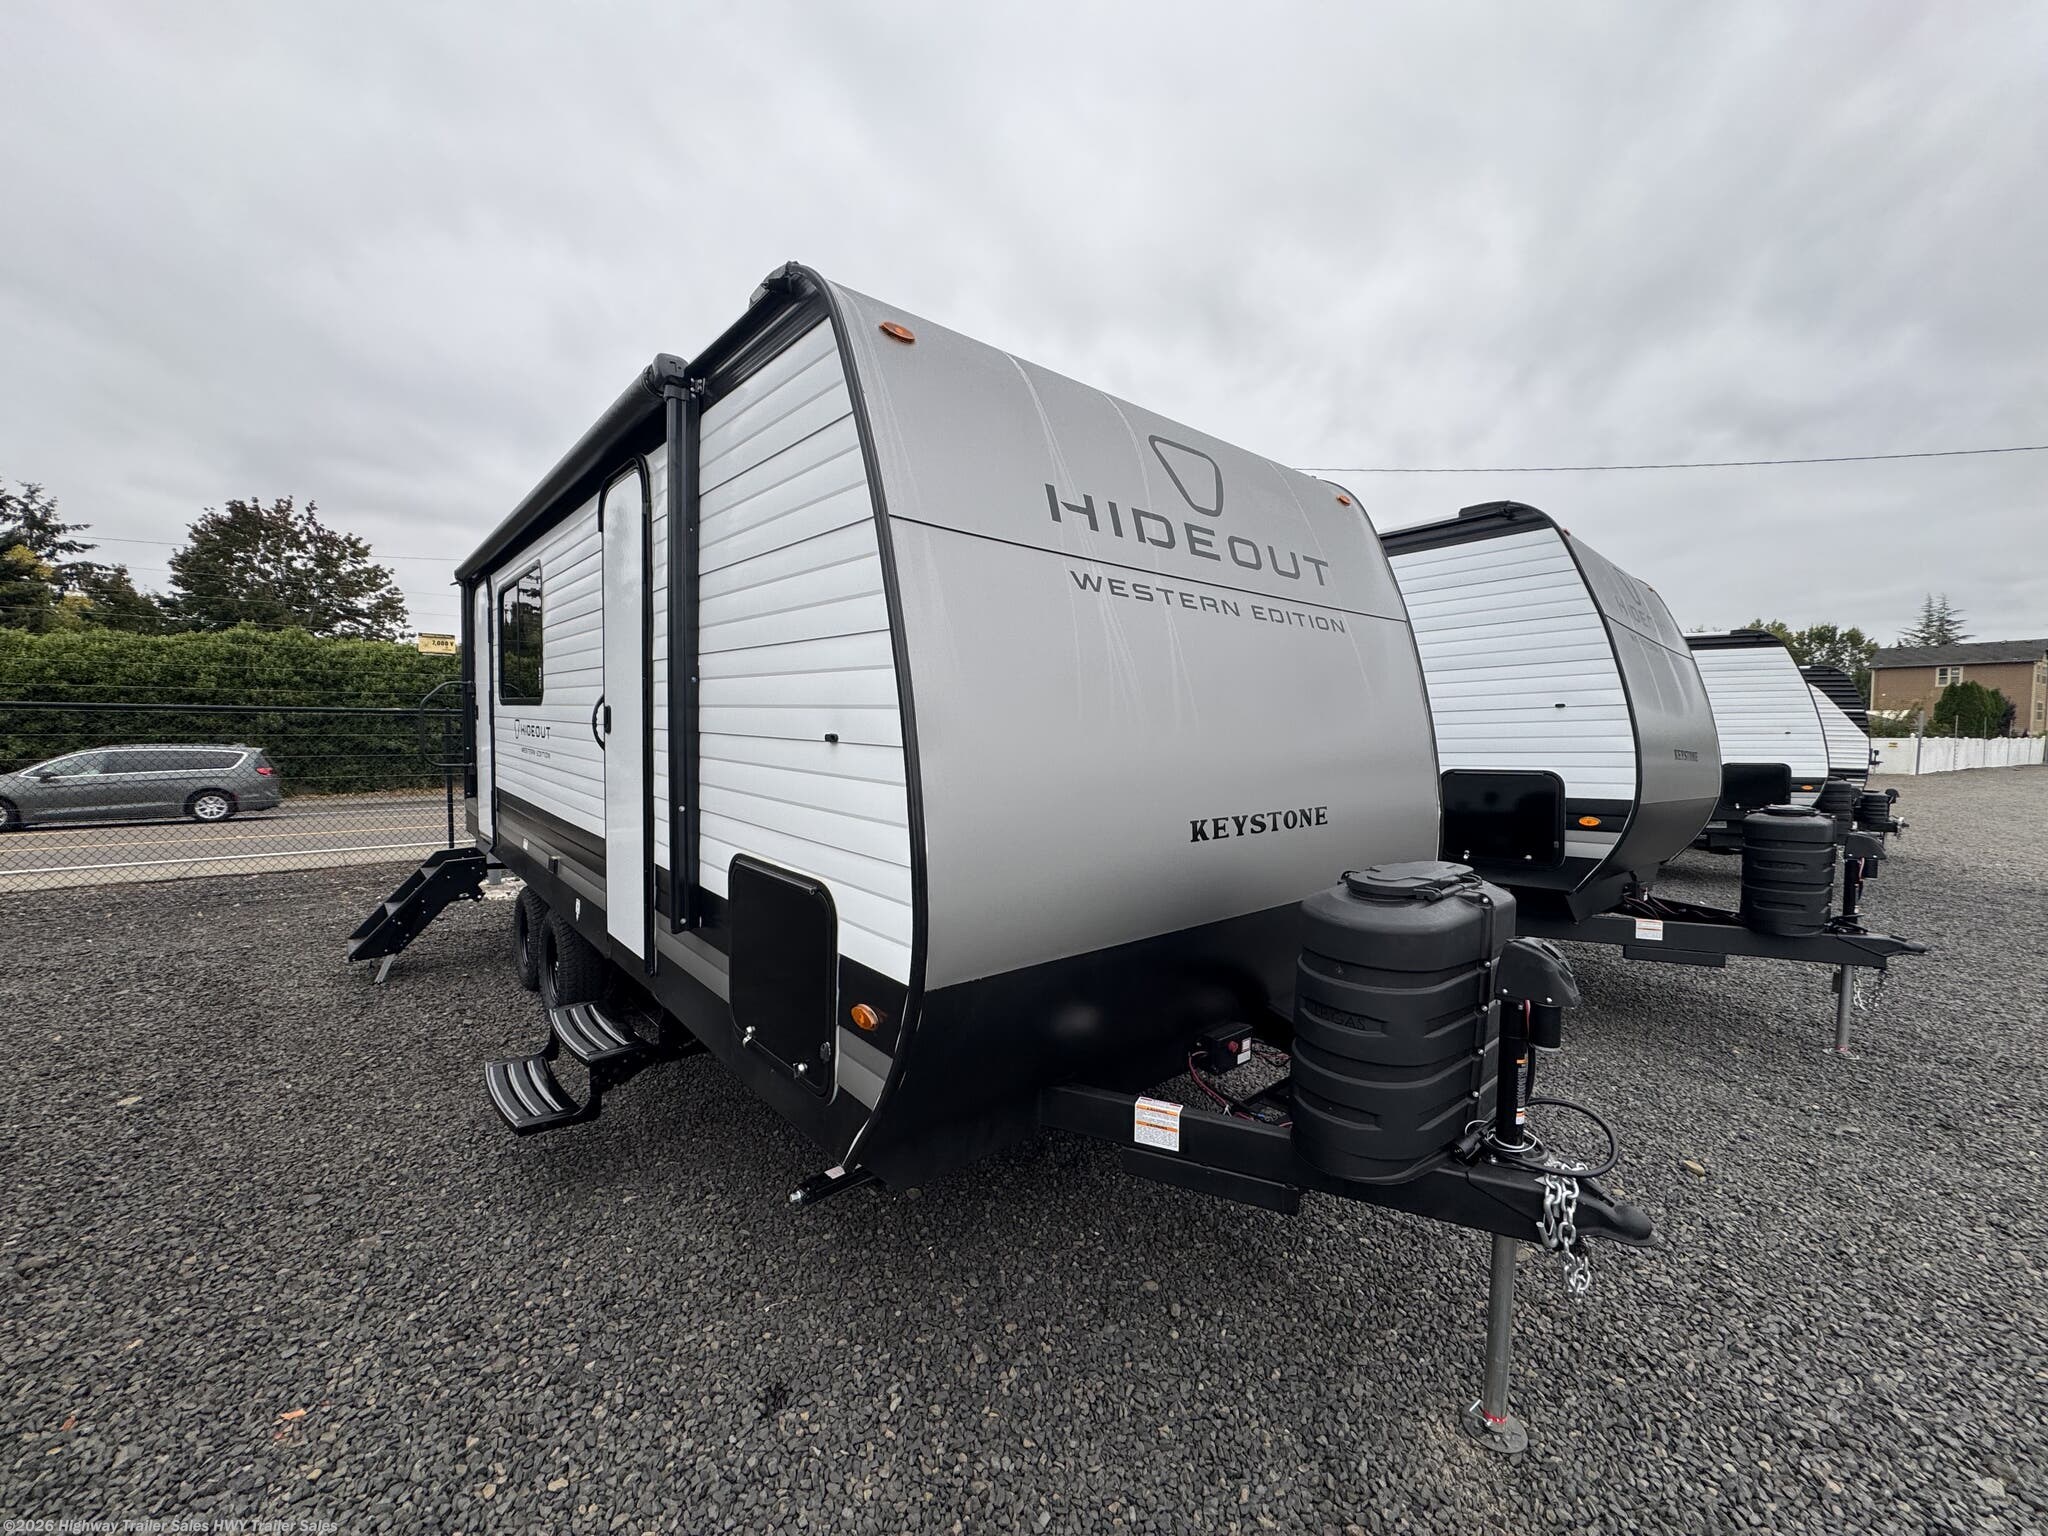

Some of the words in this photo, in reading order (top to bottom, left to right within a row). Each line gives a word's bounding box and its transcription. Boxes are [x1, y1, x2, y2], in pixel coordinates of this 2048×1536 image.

[1045, 483, 1329, 586] HIDEOUT
[1069, 570, 1241, 617] WESTERN
[1251, 605, 1346, 633] EDITION
[520, 723, 551, 739] HIDEOUT
[1189, 805, 1328, 843] KEYSTONE
